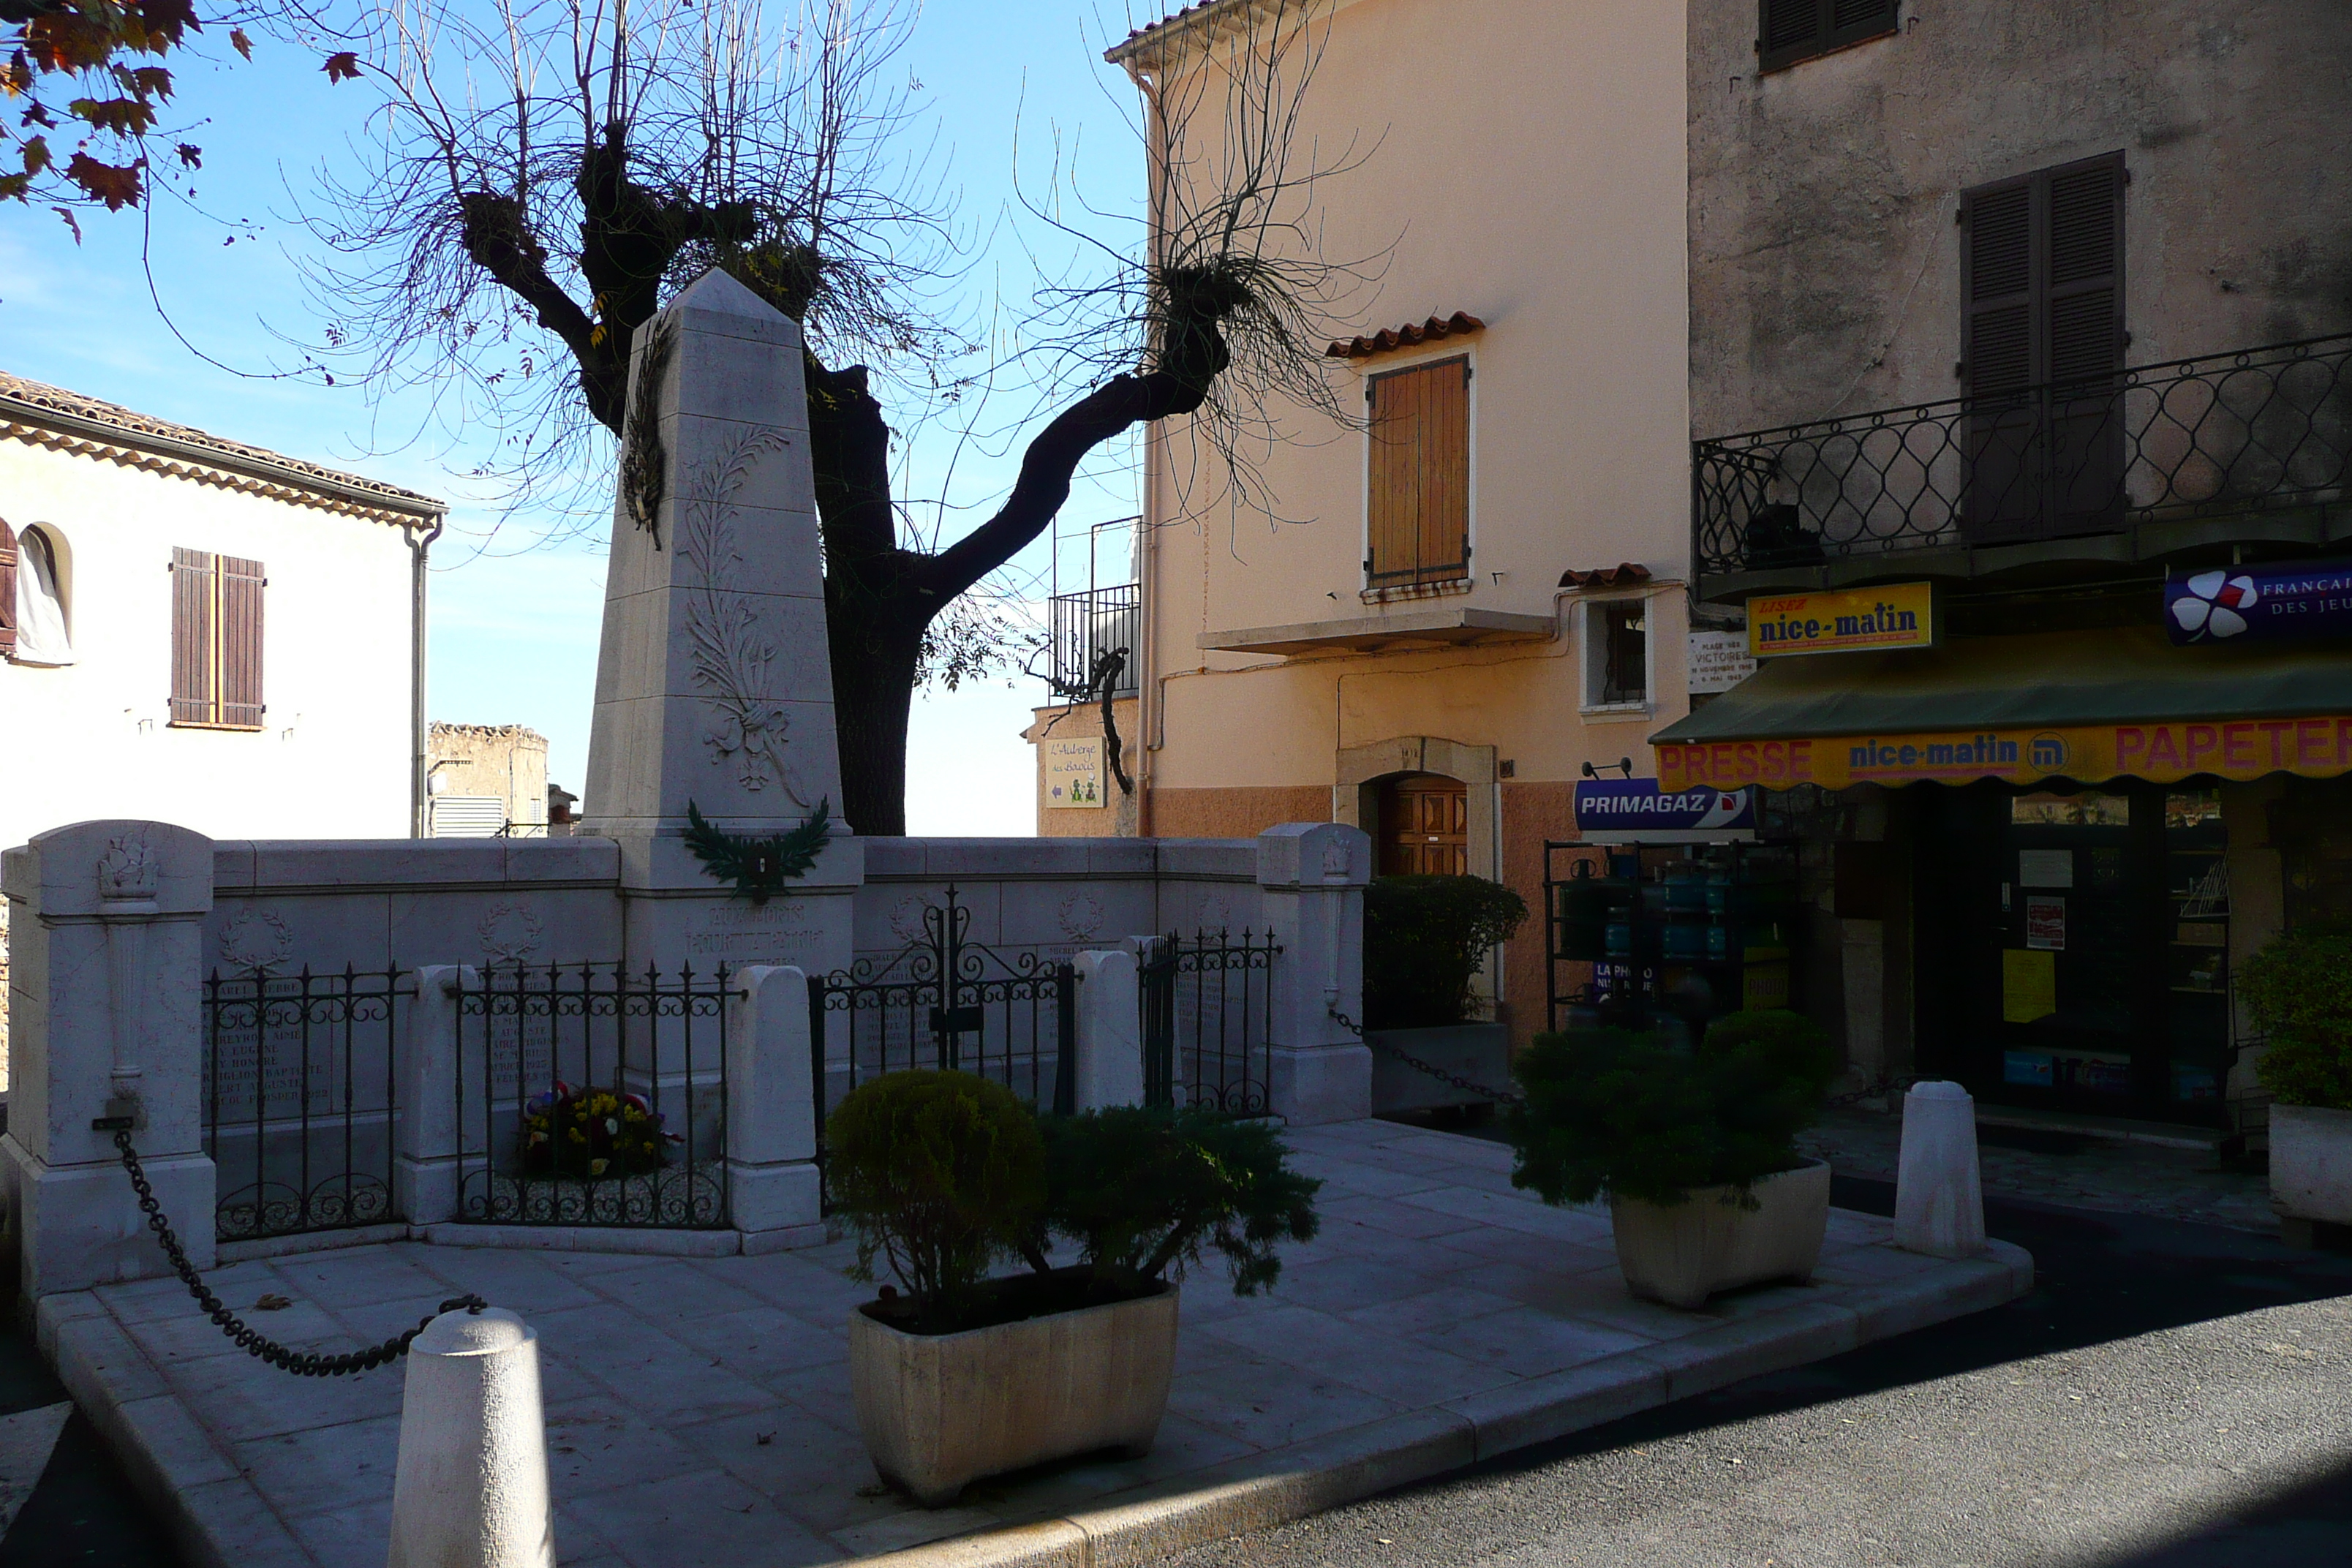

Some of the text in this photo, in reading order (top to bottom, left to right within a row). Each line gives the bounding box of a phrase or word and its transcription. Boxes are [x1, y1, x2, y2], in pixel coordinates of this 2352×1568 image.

[1759, 598, 1807, 614] LISEZ
[2271, 600, 2307, 615] DES
[1759, 602, 1917, 641] nice-matin
[1702, 642, 1723, 650] PLACE
[1695, 651, 1748, 663] VICTOIRES
[1700, 664, 1735, 673] NOVEMBRE
[1050, 743, 1096, 762] L'Auberge
[1660, 740, 1812, 782] PRESSE
[1849, 734, 2018, 768] nice-matin
[1581, 794, 1706, 813] PRIMAGAZ
[1597, 964, 1611, 976] LA
[232, 1044, 279, 1056] EUGNE
[249, 1092, 298, 1104] POSPER
